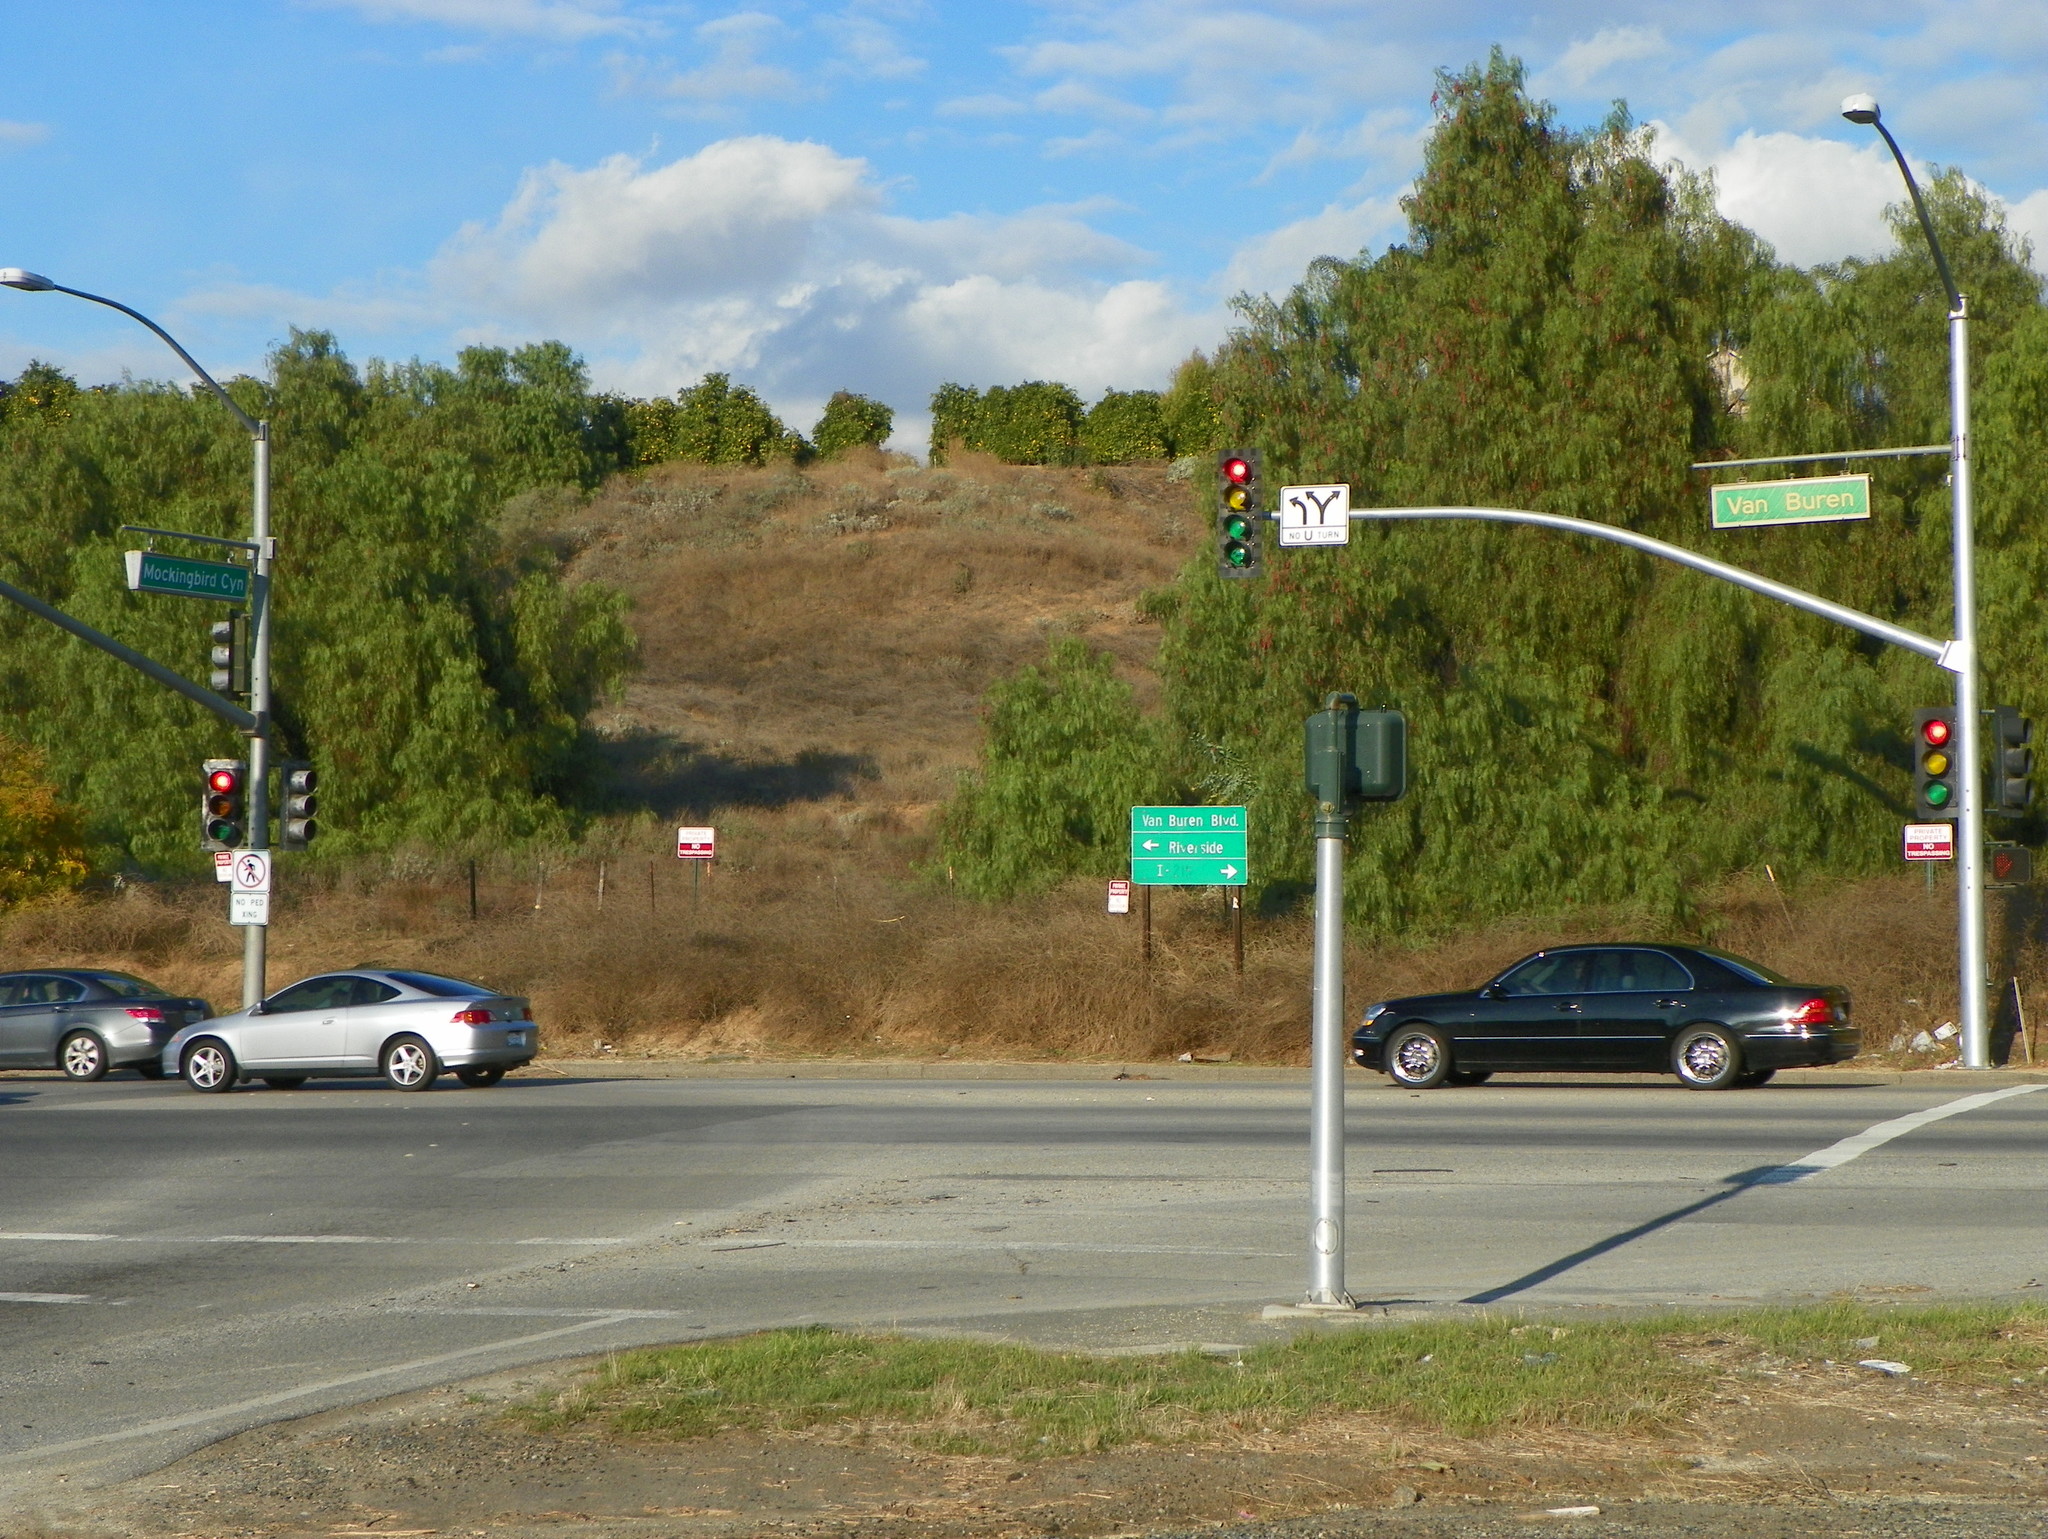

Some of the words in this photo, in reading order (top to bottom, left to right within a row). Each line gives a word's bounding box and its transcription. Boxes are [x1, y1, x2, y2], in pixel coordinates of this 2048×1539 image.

[1726, 497, 1768, 515] Van
[1785, 492, 1854, 511] Buren
[1289, 532, 1301, 540] NO
[1304, 530, 1313, 541] U
[1317, 531, 1339, 539] TURN
[143, 563, 217, 588] Mockingbird
[221, 573, 244, 593] Cyn
[1142, 814, 1162, 827] Van
[1168, 814, 1203, 827] Buren
[1211, 814, 1239, 827] Blvd.
[1168, 841, 1223, 854] Riverside
